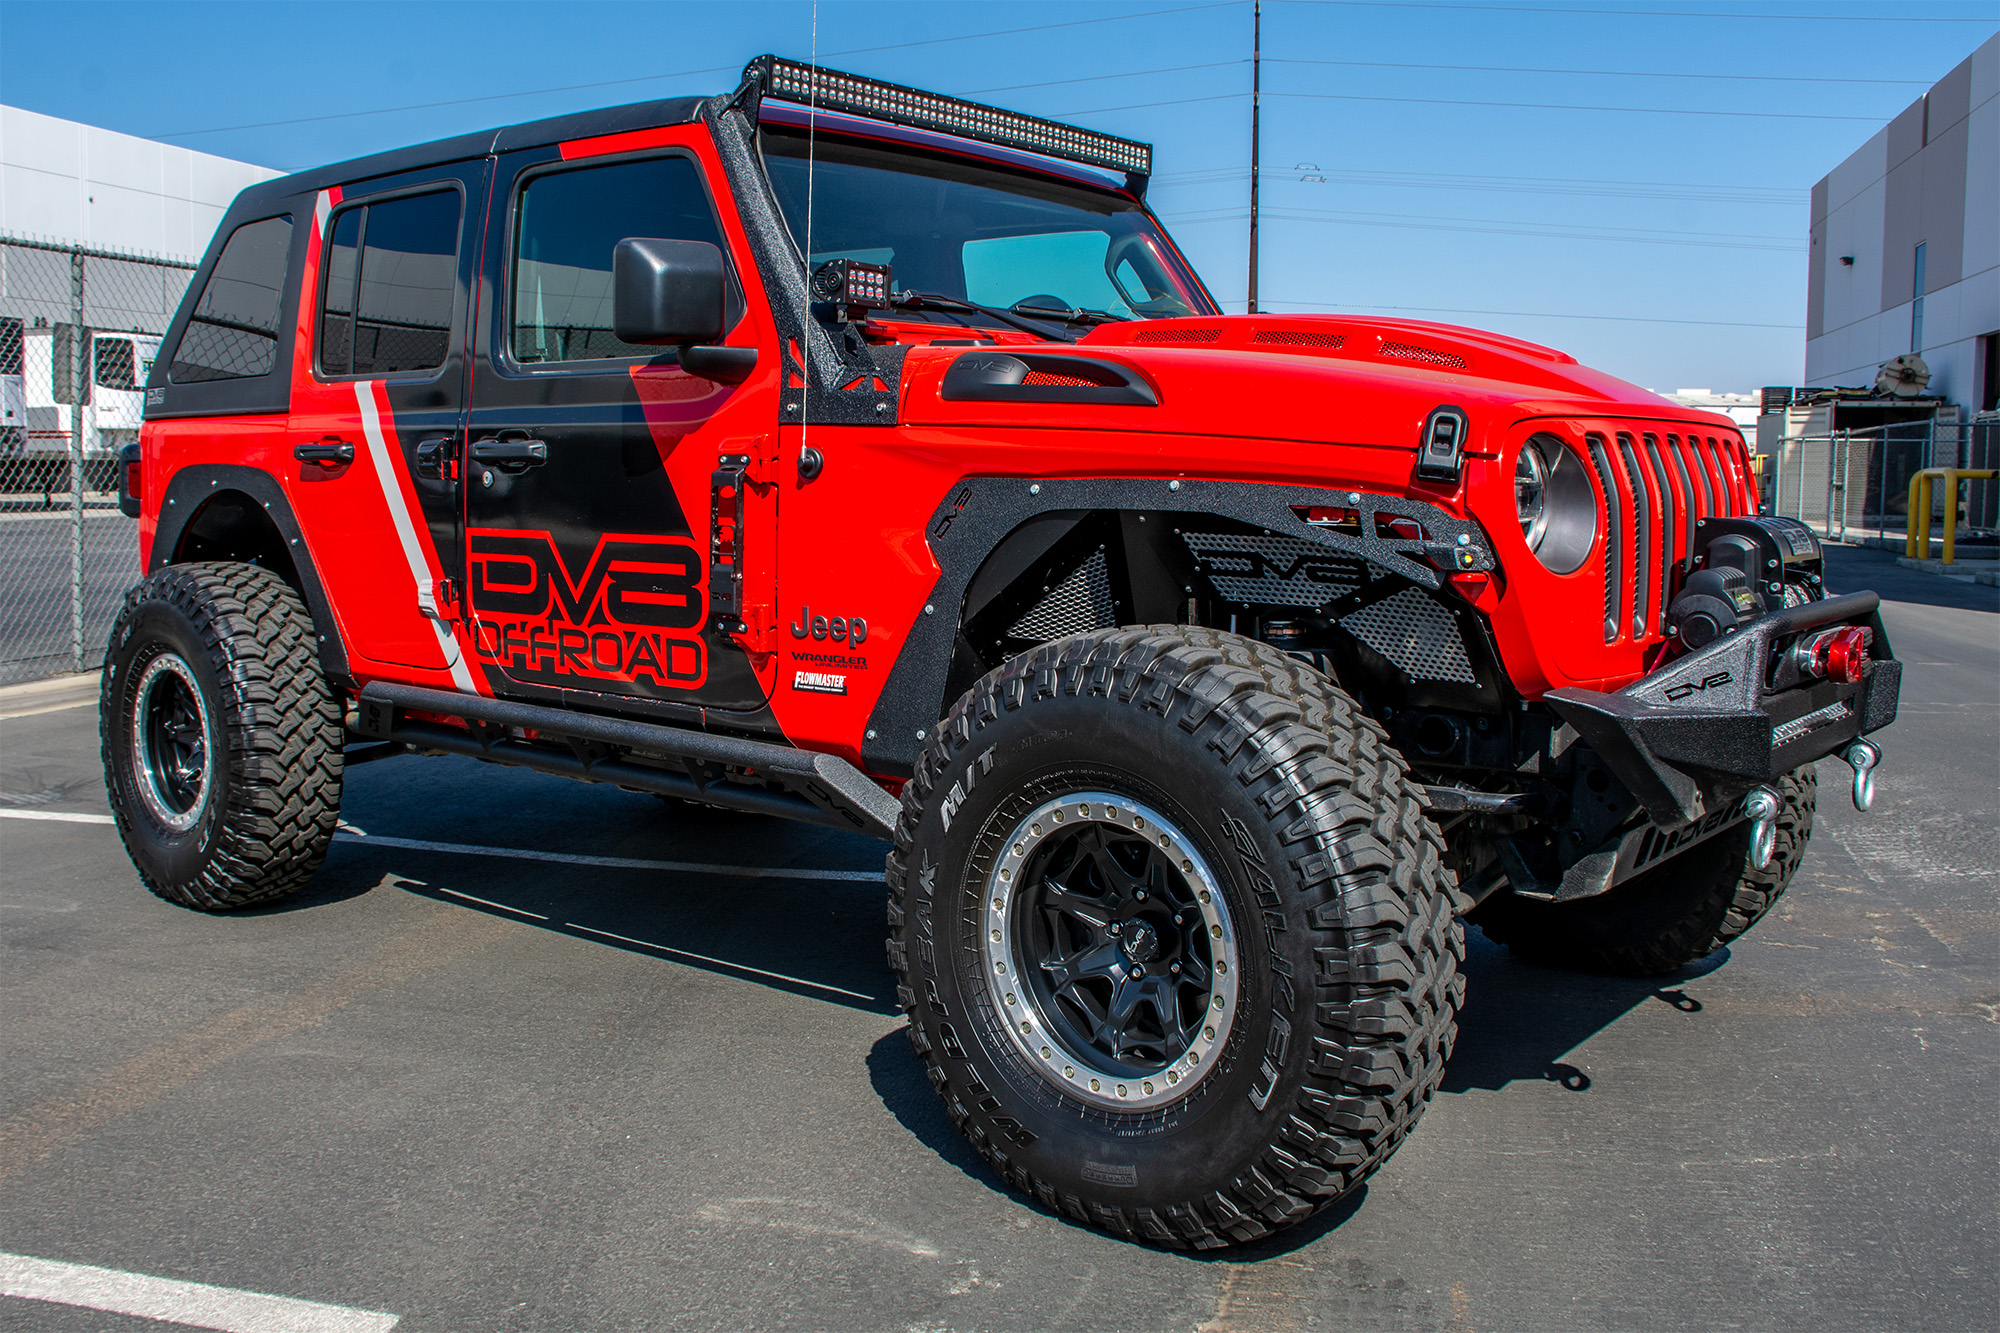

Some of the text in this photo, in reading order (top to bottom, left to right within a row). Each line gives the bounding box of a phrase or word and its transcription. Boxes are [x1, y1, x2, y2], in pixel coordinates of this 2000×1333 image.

[954, 360, 1015, 374] DV8
[933, 486, 973, 540] DV8
[471, 535, 703, 629] DV8
[1191, 548, 1368, 588] DV8
[474, 619, 702, 681] OFFROAD
[790, 605, 867, 650] Jeep
[791, 651, 867, 666] WRANGLER
[1664, 671, 1734, 702] DV8
[806, 780, 866, 828] DV8
